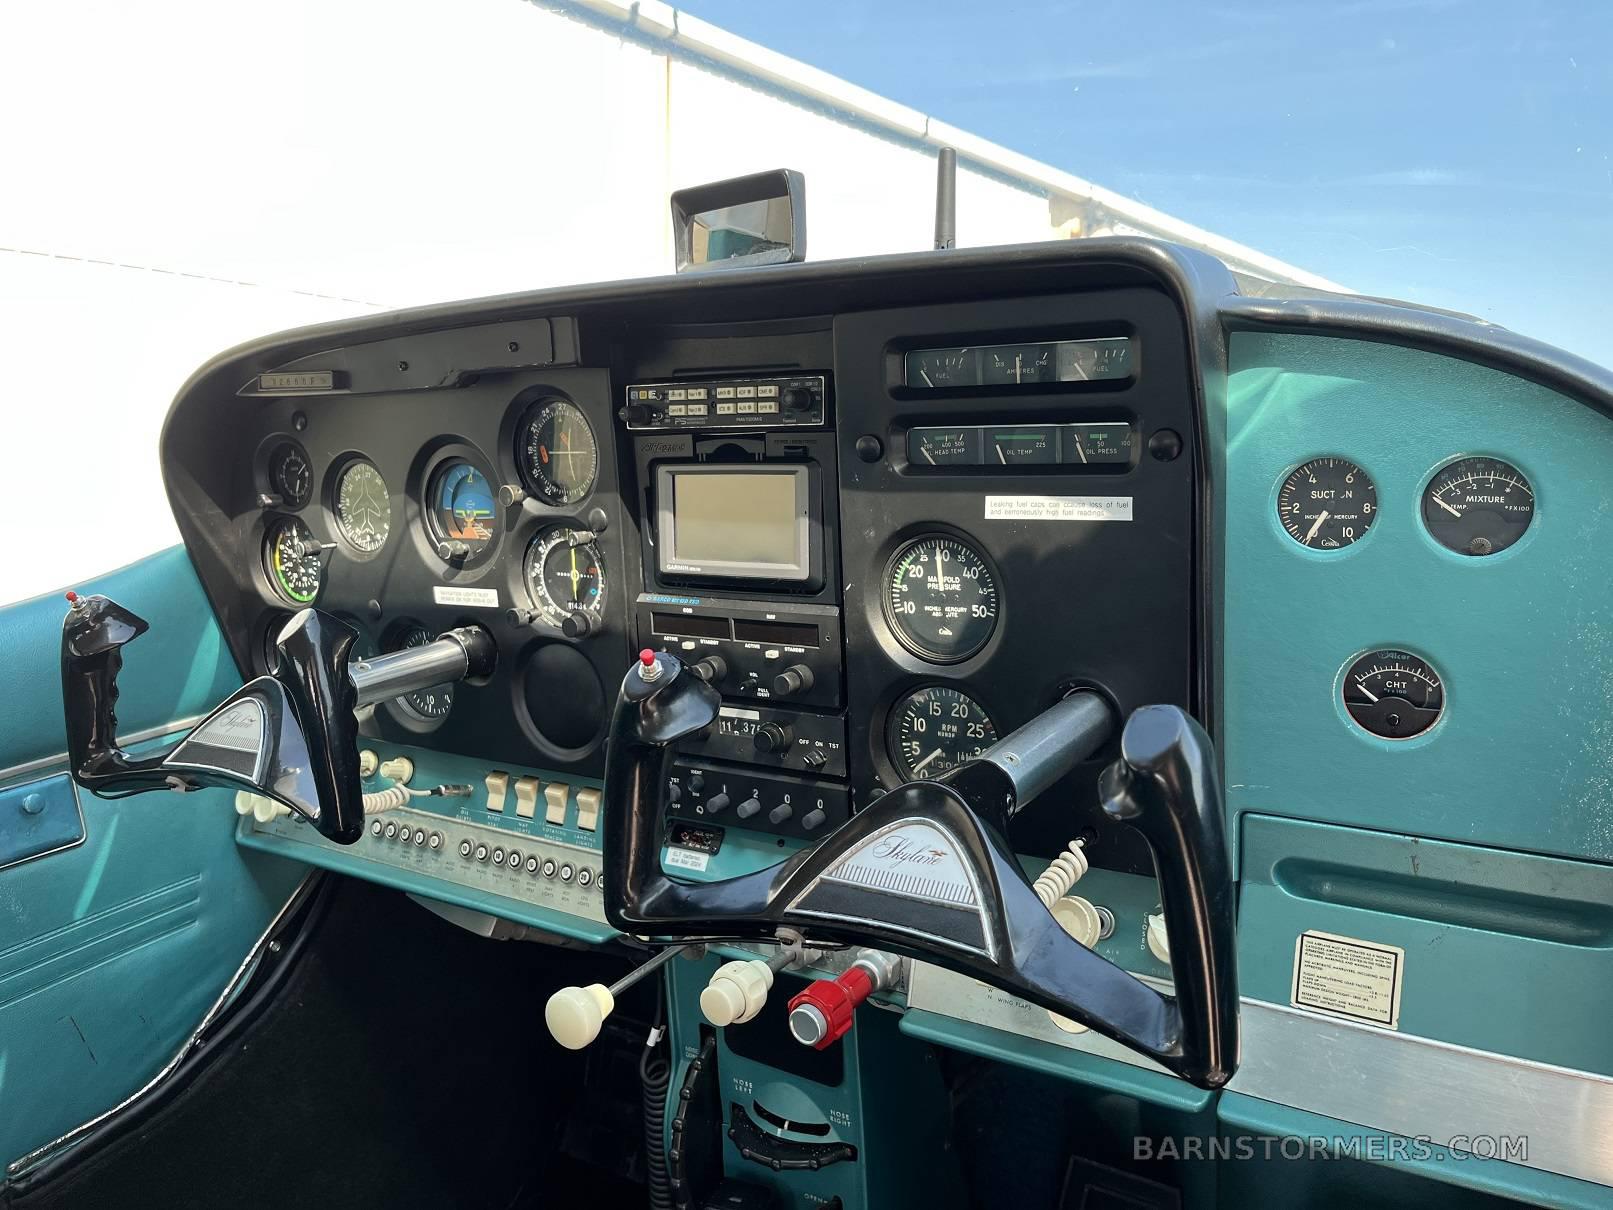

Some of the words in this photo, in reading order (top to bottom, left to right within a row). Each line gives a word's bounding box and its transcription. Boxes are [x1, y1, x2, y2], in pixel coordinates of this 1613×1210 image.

[1309, 474, 1317, 484] 4
[1346, 472, 1354, 483] 6
[1311, 490, 1353, 499] SUCTN
[1293, 503, 1300, 513] 2
[1363, 503, 1371, 513] 8
[552, 530, 560, 538] 30
[1343, 527, 1353, 537] 10
[909, 565, 923, 578] 20
[962, 567, 978, 579] 40
[904, 602, 915, 614] 10
[972, 604, 987, 617] 50
[427, 695, 434, 704] 10
[929, 702, 941, 716] 15
[951, 703, 968, 718] 20
[914, 718, 926, 732] 10
[942, 724, 958, 732] RPM
[966, 722, 984, 738] 25
[912, 741, 920, 755] 5
[723, 784, 726, 793] 1
[753, 788, 759, 798] 2
[784, 794, 790, 804] 0
[817, 799, 824, 809] 0
[872, 836, 943, 868] Skylane
[998, 998, 1013, 1006] WING
[1016, 1001, 1031, 1010] FLAPS
[733, 1078, 752, 1088] NOSE
[736, 1086, 752, 1094] LEFT
[831, 1109, 850, 1120] NOSE
[830, 1116, 851, 1127] RIGHT
